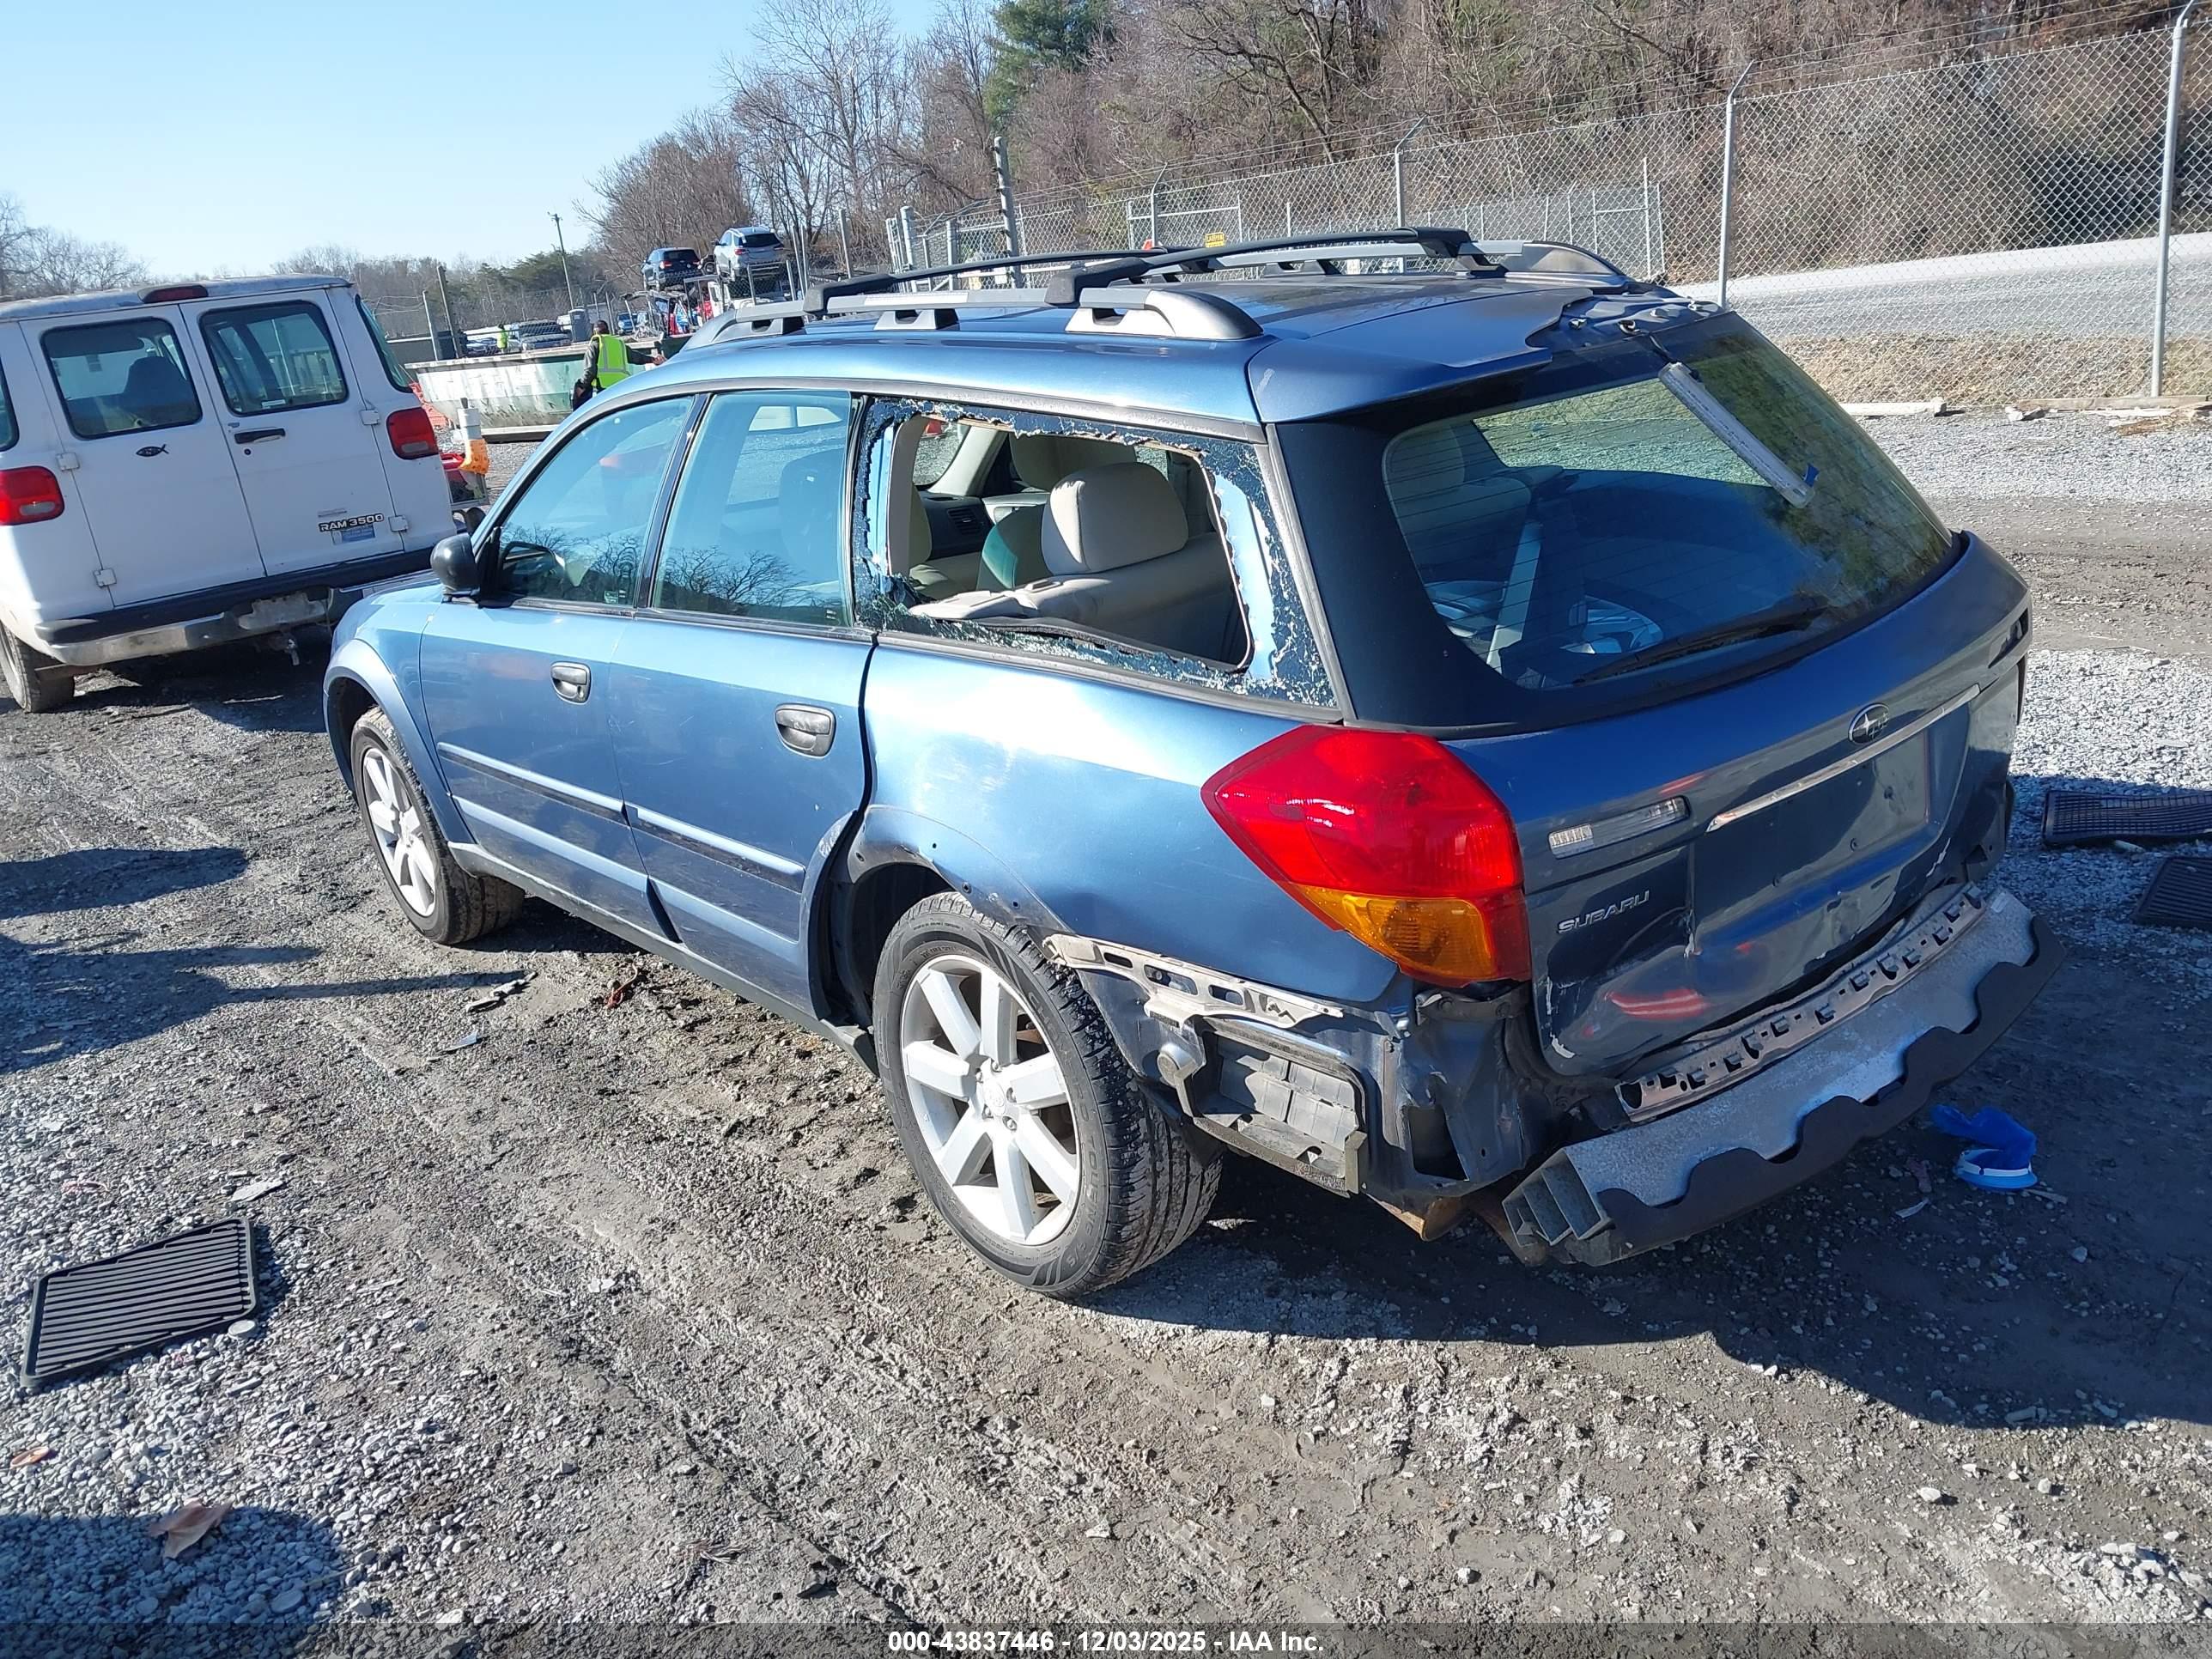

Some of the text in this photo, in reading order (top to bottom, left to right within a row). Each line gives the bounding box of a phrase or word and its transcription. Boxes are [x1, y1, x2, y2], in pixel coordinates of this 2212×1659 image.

[319, 520, 348, 532] RAM
[348, 513, 385, 527] 3500
[1557, 890, 1650, 934] SUBARU
